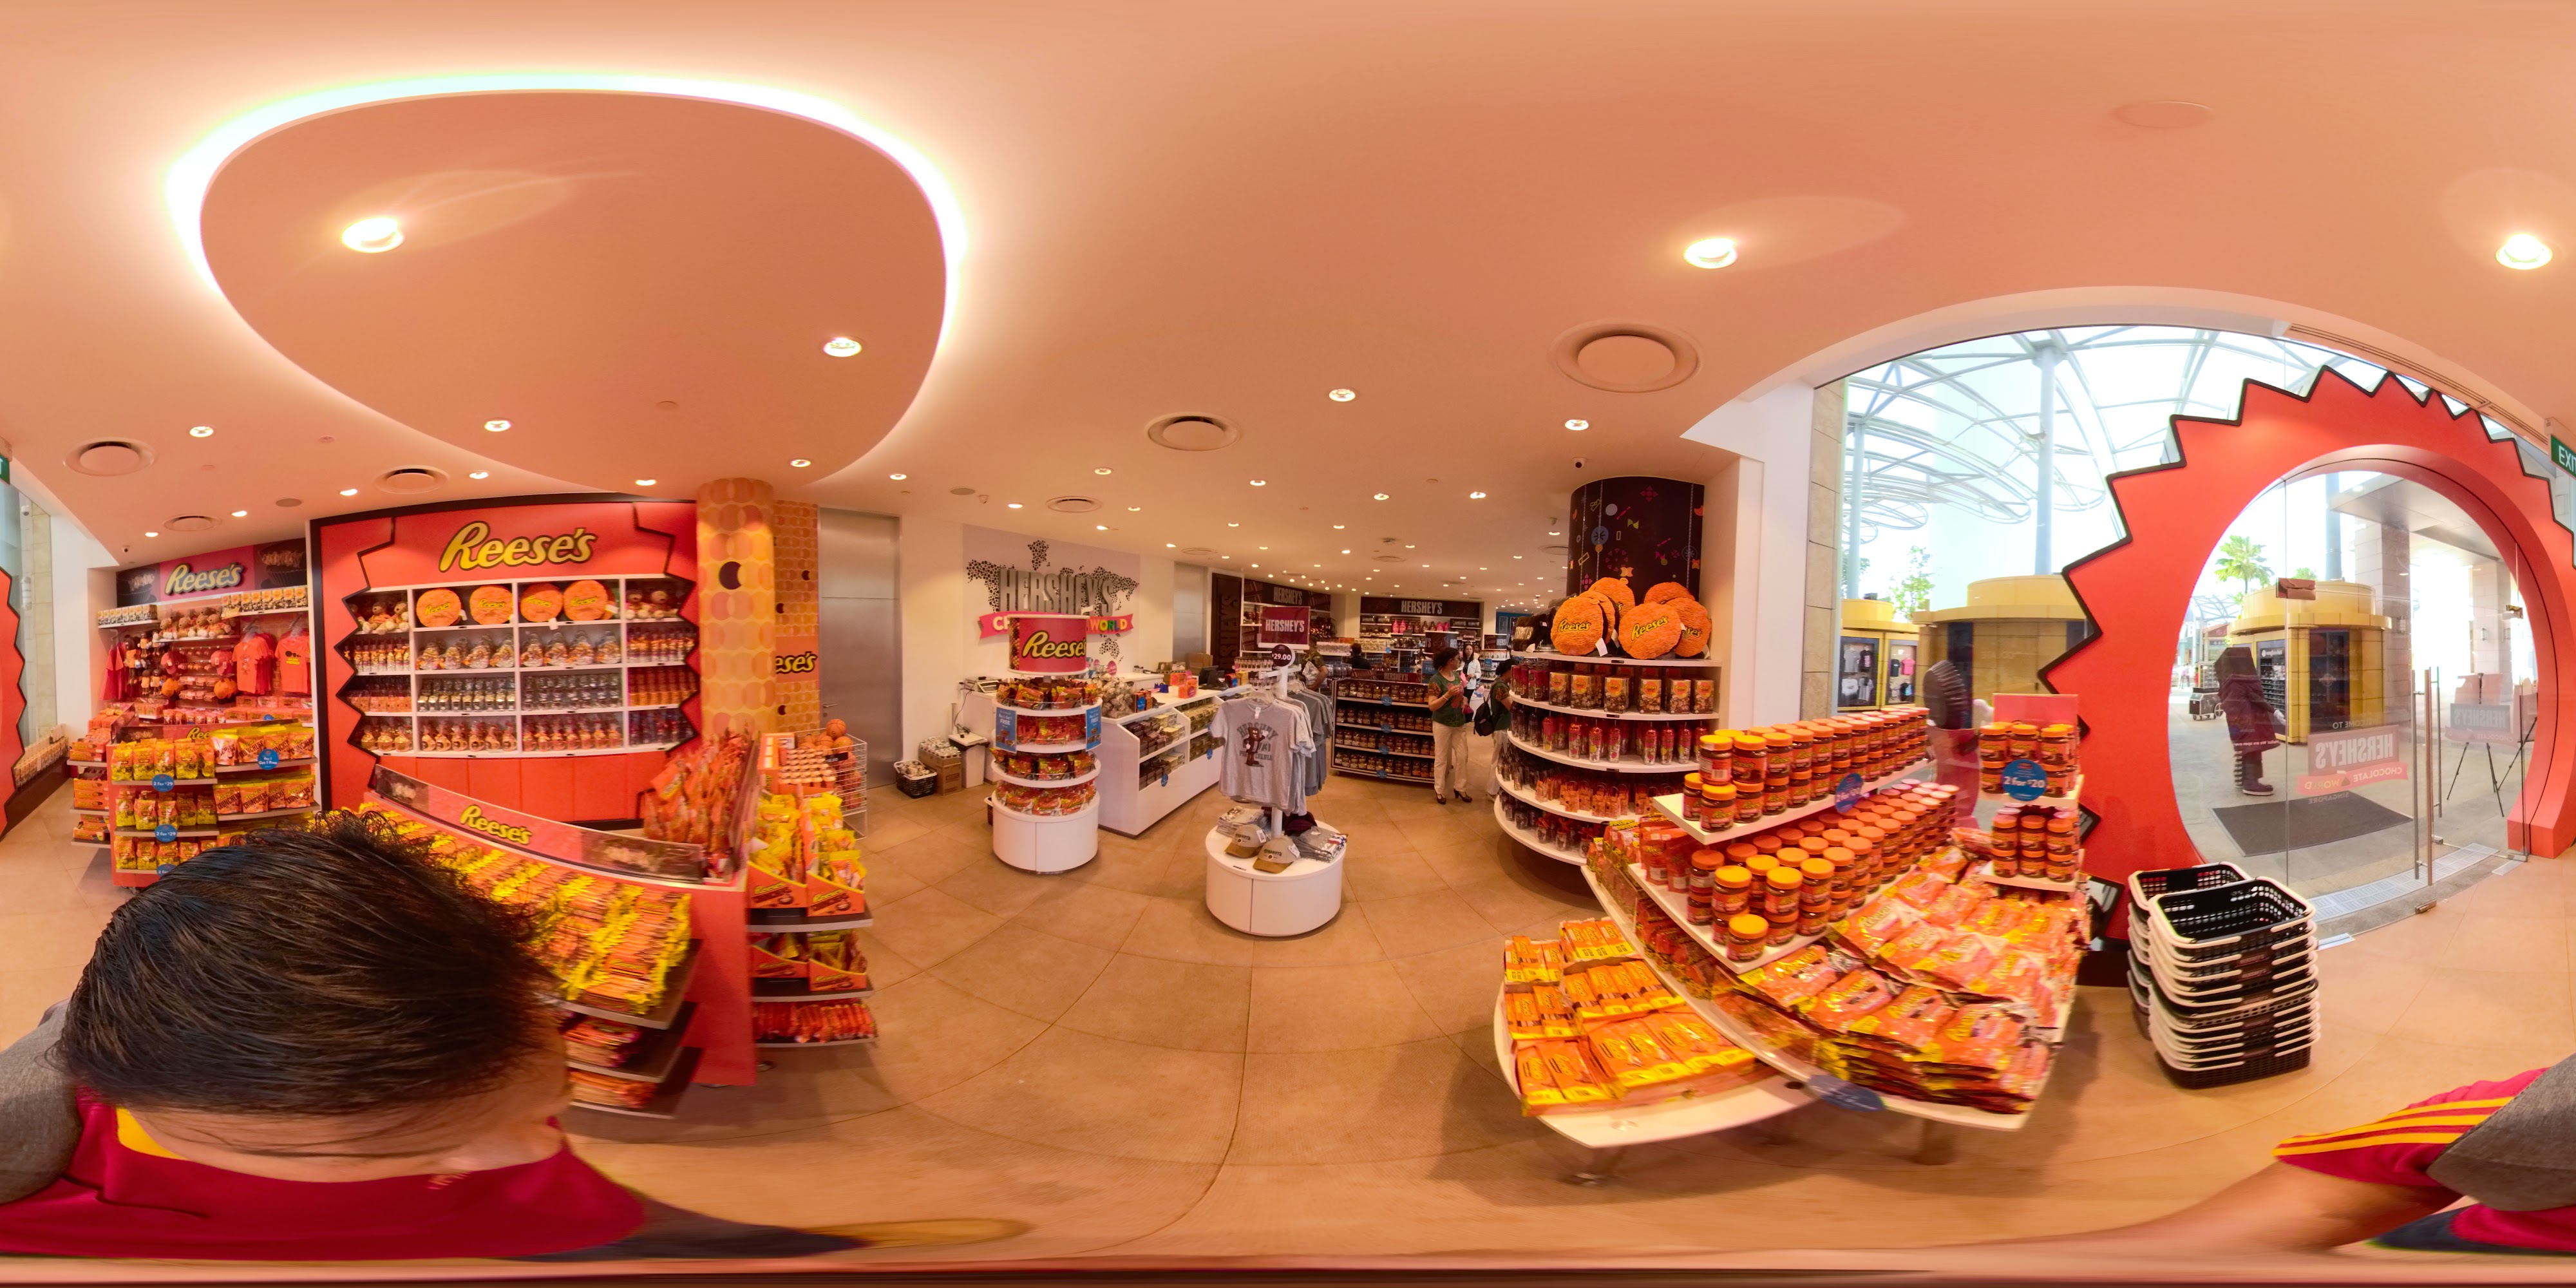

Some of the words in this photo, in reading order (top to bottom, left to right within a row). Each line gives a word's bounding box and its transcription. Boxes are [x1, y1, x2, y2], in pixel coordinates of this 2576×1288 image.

[439, 520, 599, 573] Reese's
[165, 562, 243, 596] Reese's
[998, 569, 1113, 616] HERSHEY'S
[1274, 587, 1302, 605] HERSHEY'S
[1401, 600, 1443, 614] HERSHEY'S
[1089, 618, 1127, 632] WORLD
[1265, 620, 1305, 632] HERSHEY'S
[1558, 620, 1592, 632] Reese's
[1631, 616, 1669, 641] Reese's
[775, 651, 818, 674] ese's
[1385, 672, 1408, 681] HERSHEY'S
[2012, 777, 2026, 786] for
[460, 804, 533, 845] Reese's
